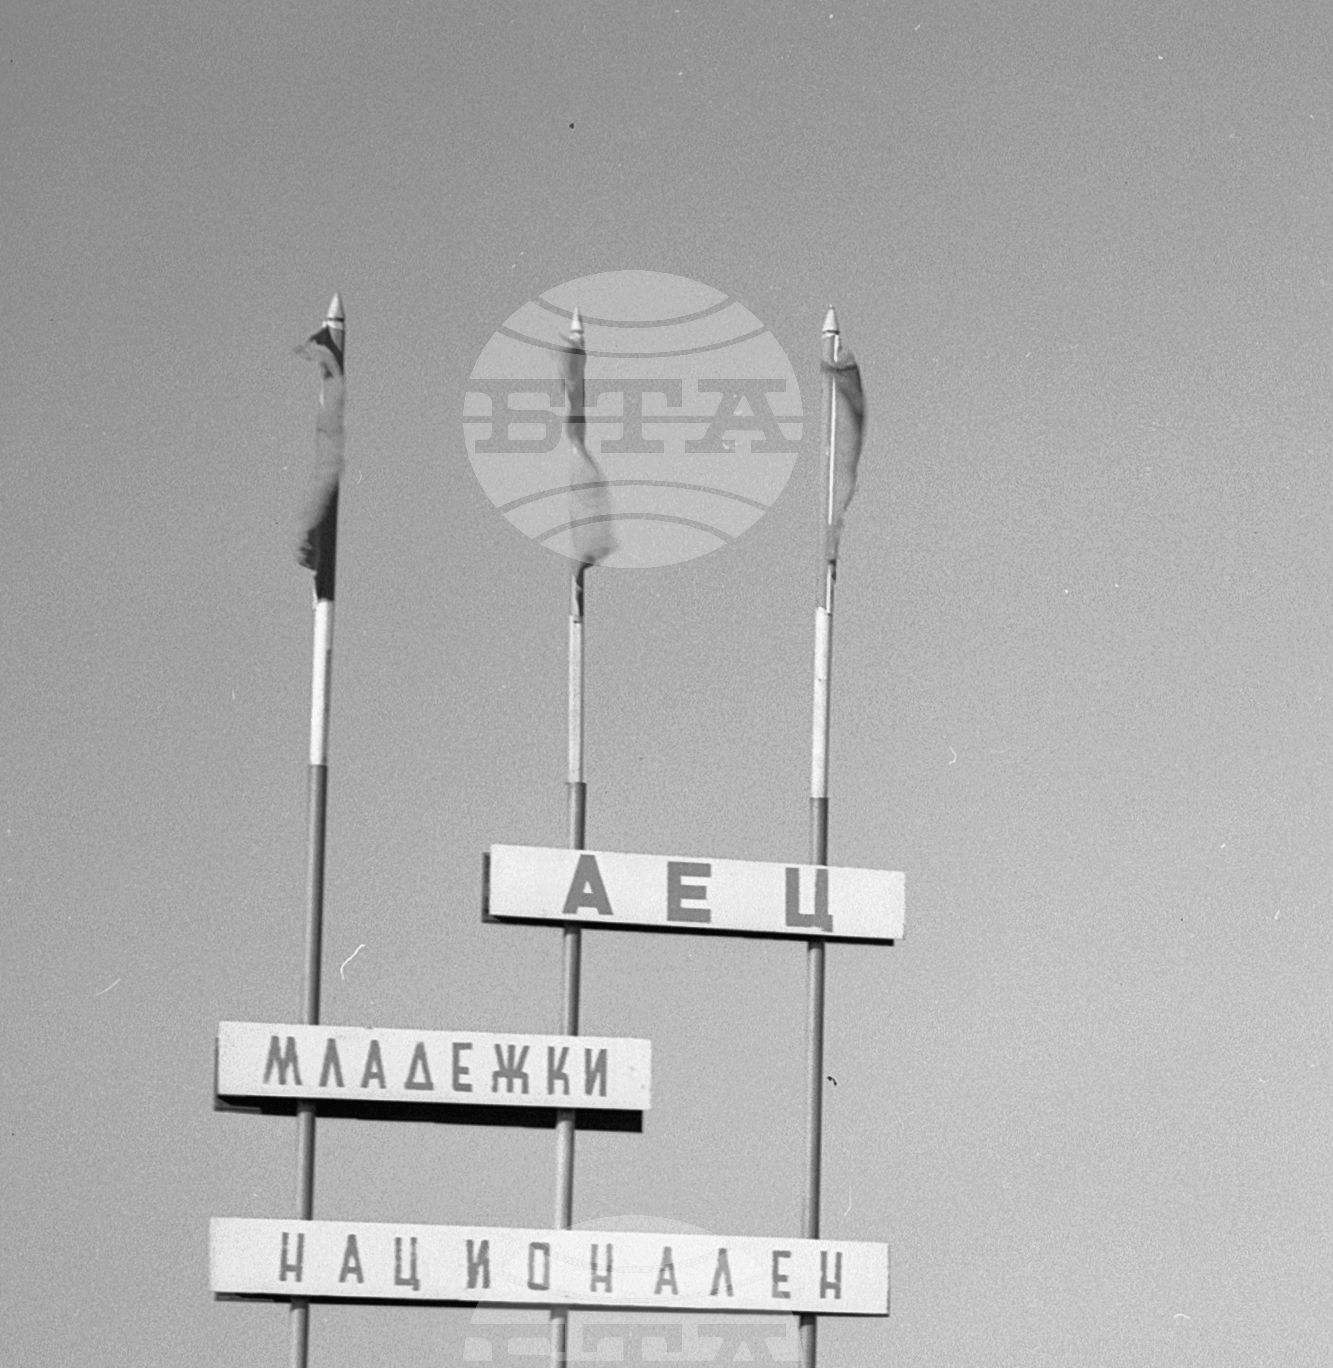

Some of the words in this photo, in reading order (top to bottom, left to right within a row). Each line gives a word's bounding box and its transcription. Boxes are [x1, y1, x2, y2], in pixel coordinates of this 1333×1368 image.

[562, 854, 833, 932] АЕЦ
[263, 1035, 608, 1097] МЛАДЕЖКИ
[279, 1232, 843, 1300] НАЦИОНАЛЕН
